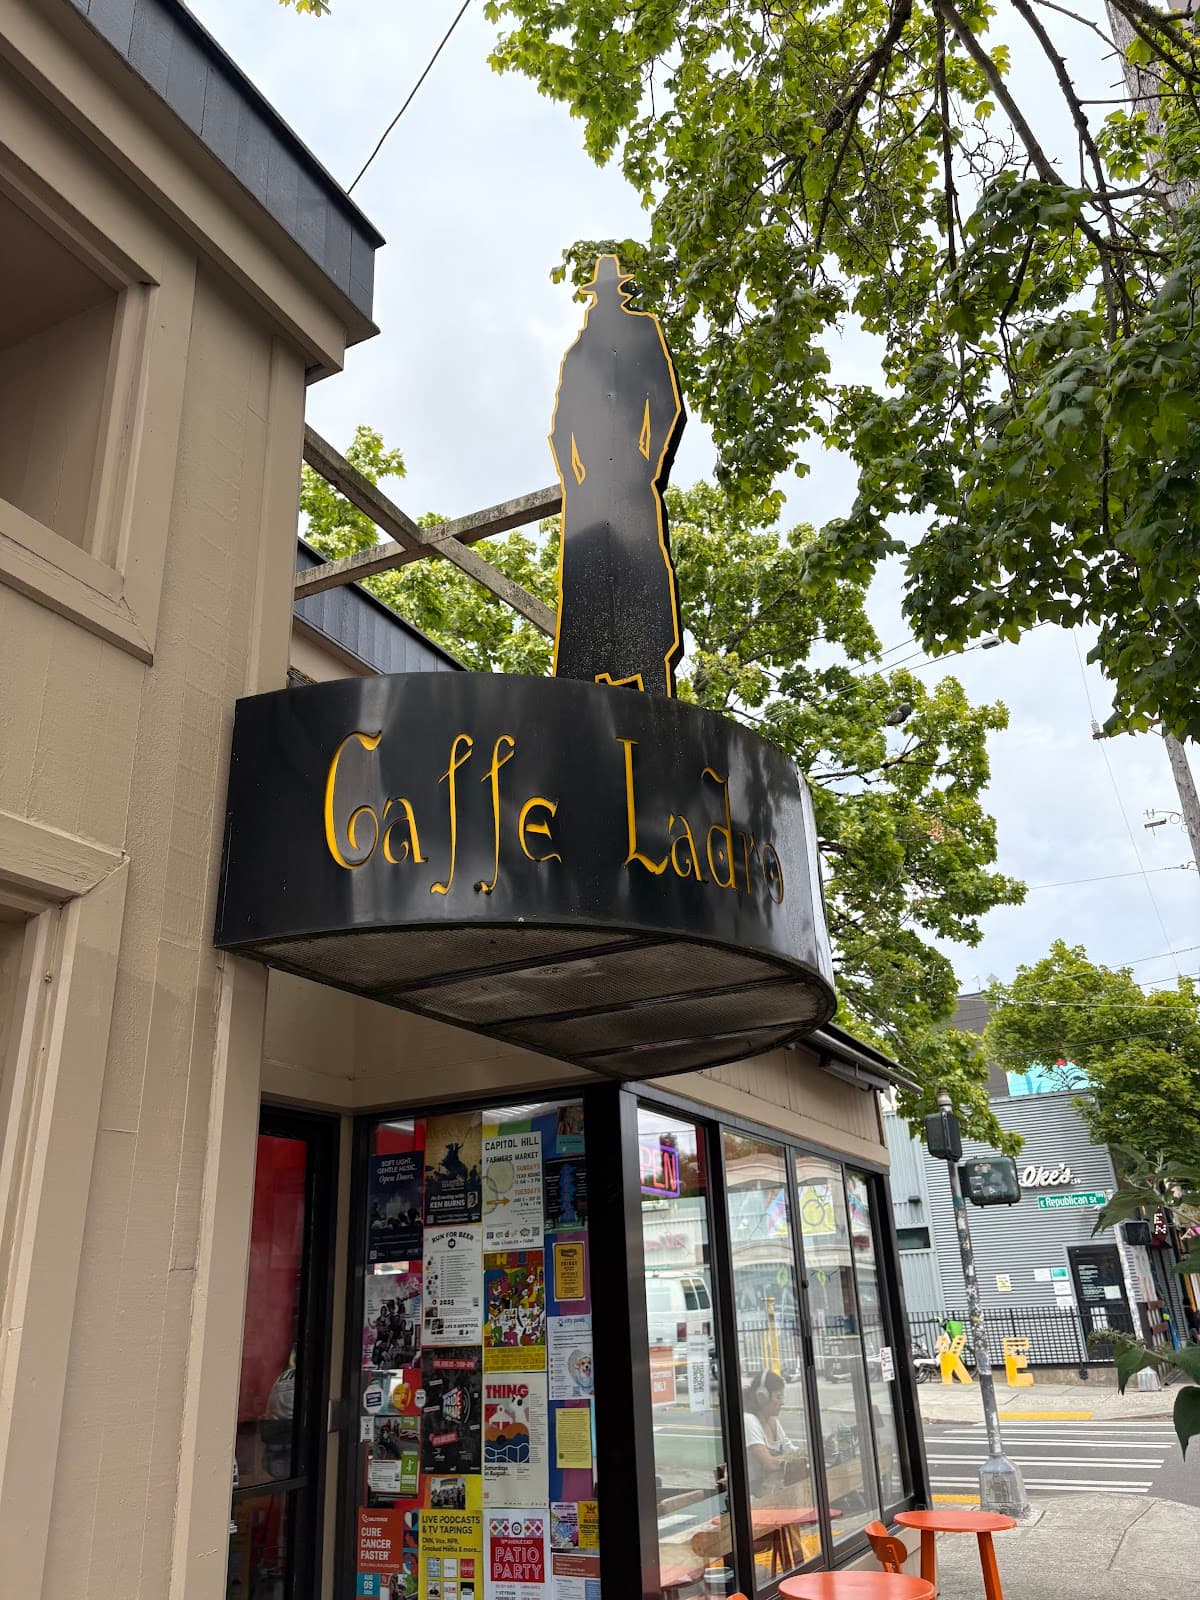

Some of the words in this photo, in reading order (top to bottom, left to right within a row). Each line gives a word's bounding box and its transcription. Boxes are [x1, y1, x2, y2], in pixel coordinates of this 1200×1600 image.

[323, 730, 562, 895] Caffe
[615, 737, 784, 904] Ladro
[485, 1138, 518, 1151] CAPITOL
[520, 1136, 539, 1147] HILL
[486, 1154, 513, 1164] FARMERS
[514, 1152, 538, 1161] MARKET
[640, 1146, 676, 1192] PEN
[430, 1201, 444, 1209] KEN
[444, 1199, 466, 1208] BURNS
[1046, 1194, 1089, 1208] Republican
[1089, 1196, 1097, 1204] St
[432, 1234, 445, 1243] RUN
[458, 1232, 474, 1241] BEER
[485, 1384, 529, 1399] THING
[422, 1516, 439, 1524] LIVE
[440, 1516, 481, 1524] PODCASTS
[361, 1527, 382, 1537] CURE
[428, 1526, 438, 1534] TV
[439, 1526, 473, 1535] TAPINGS
[361, 1539, 391, 1549] CANCER
[361, 1551, 389, 1561] FASTER
[495, 1547, 539, 1563] PATIO
[494, 1563, 542, 1579] PARTY
